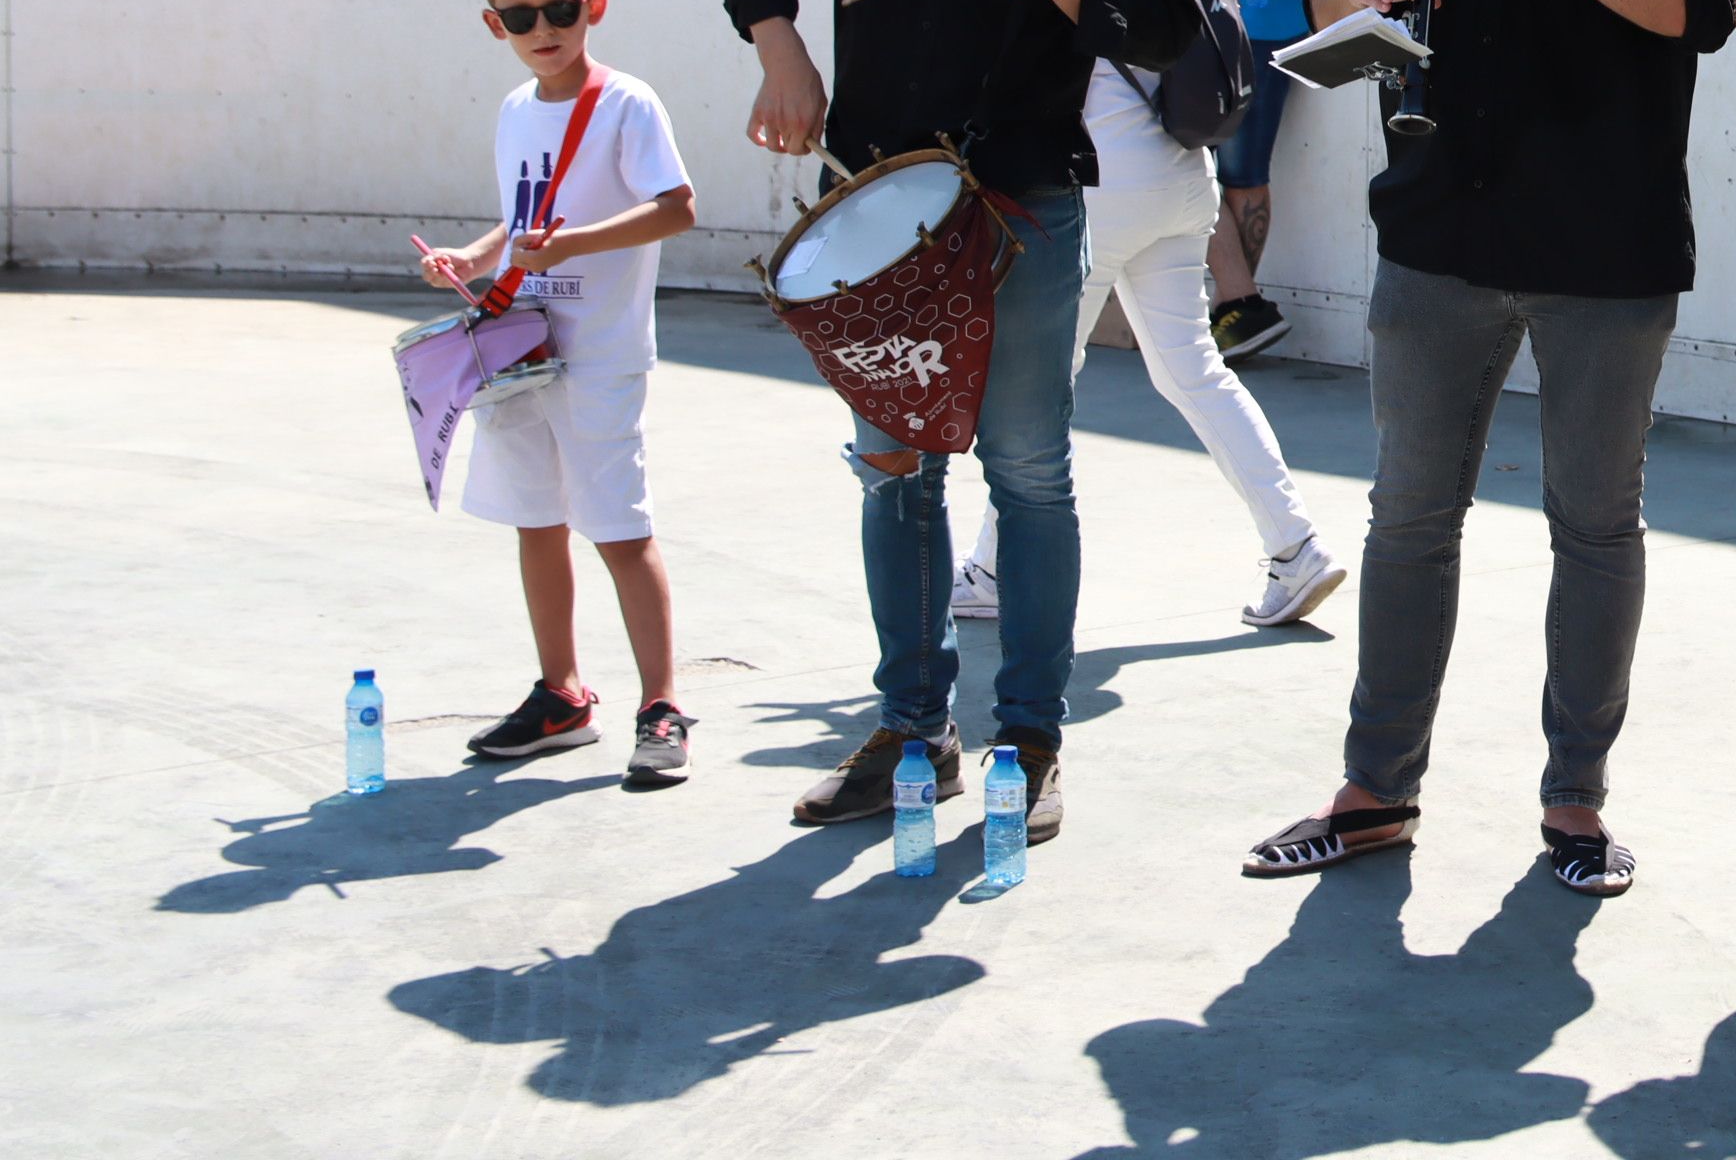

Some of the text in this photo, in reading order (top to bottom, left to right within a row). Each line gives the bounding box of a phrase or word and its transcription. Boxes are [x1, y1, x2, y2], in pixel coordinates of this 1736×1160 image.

[535, 281, 549, 295] DE
[552, 281, 580, 295] RUBÍ
[832, 334, 917, 373] FESTA
[430, 447, 443, 470] DE
